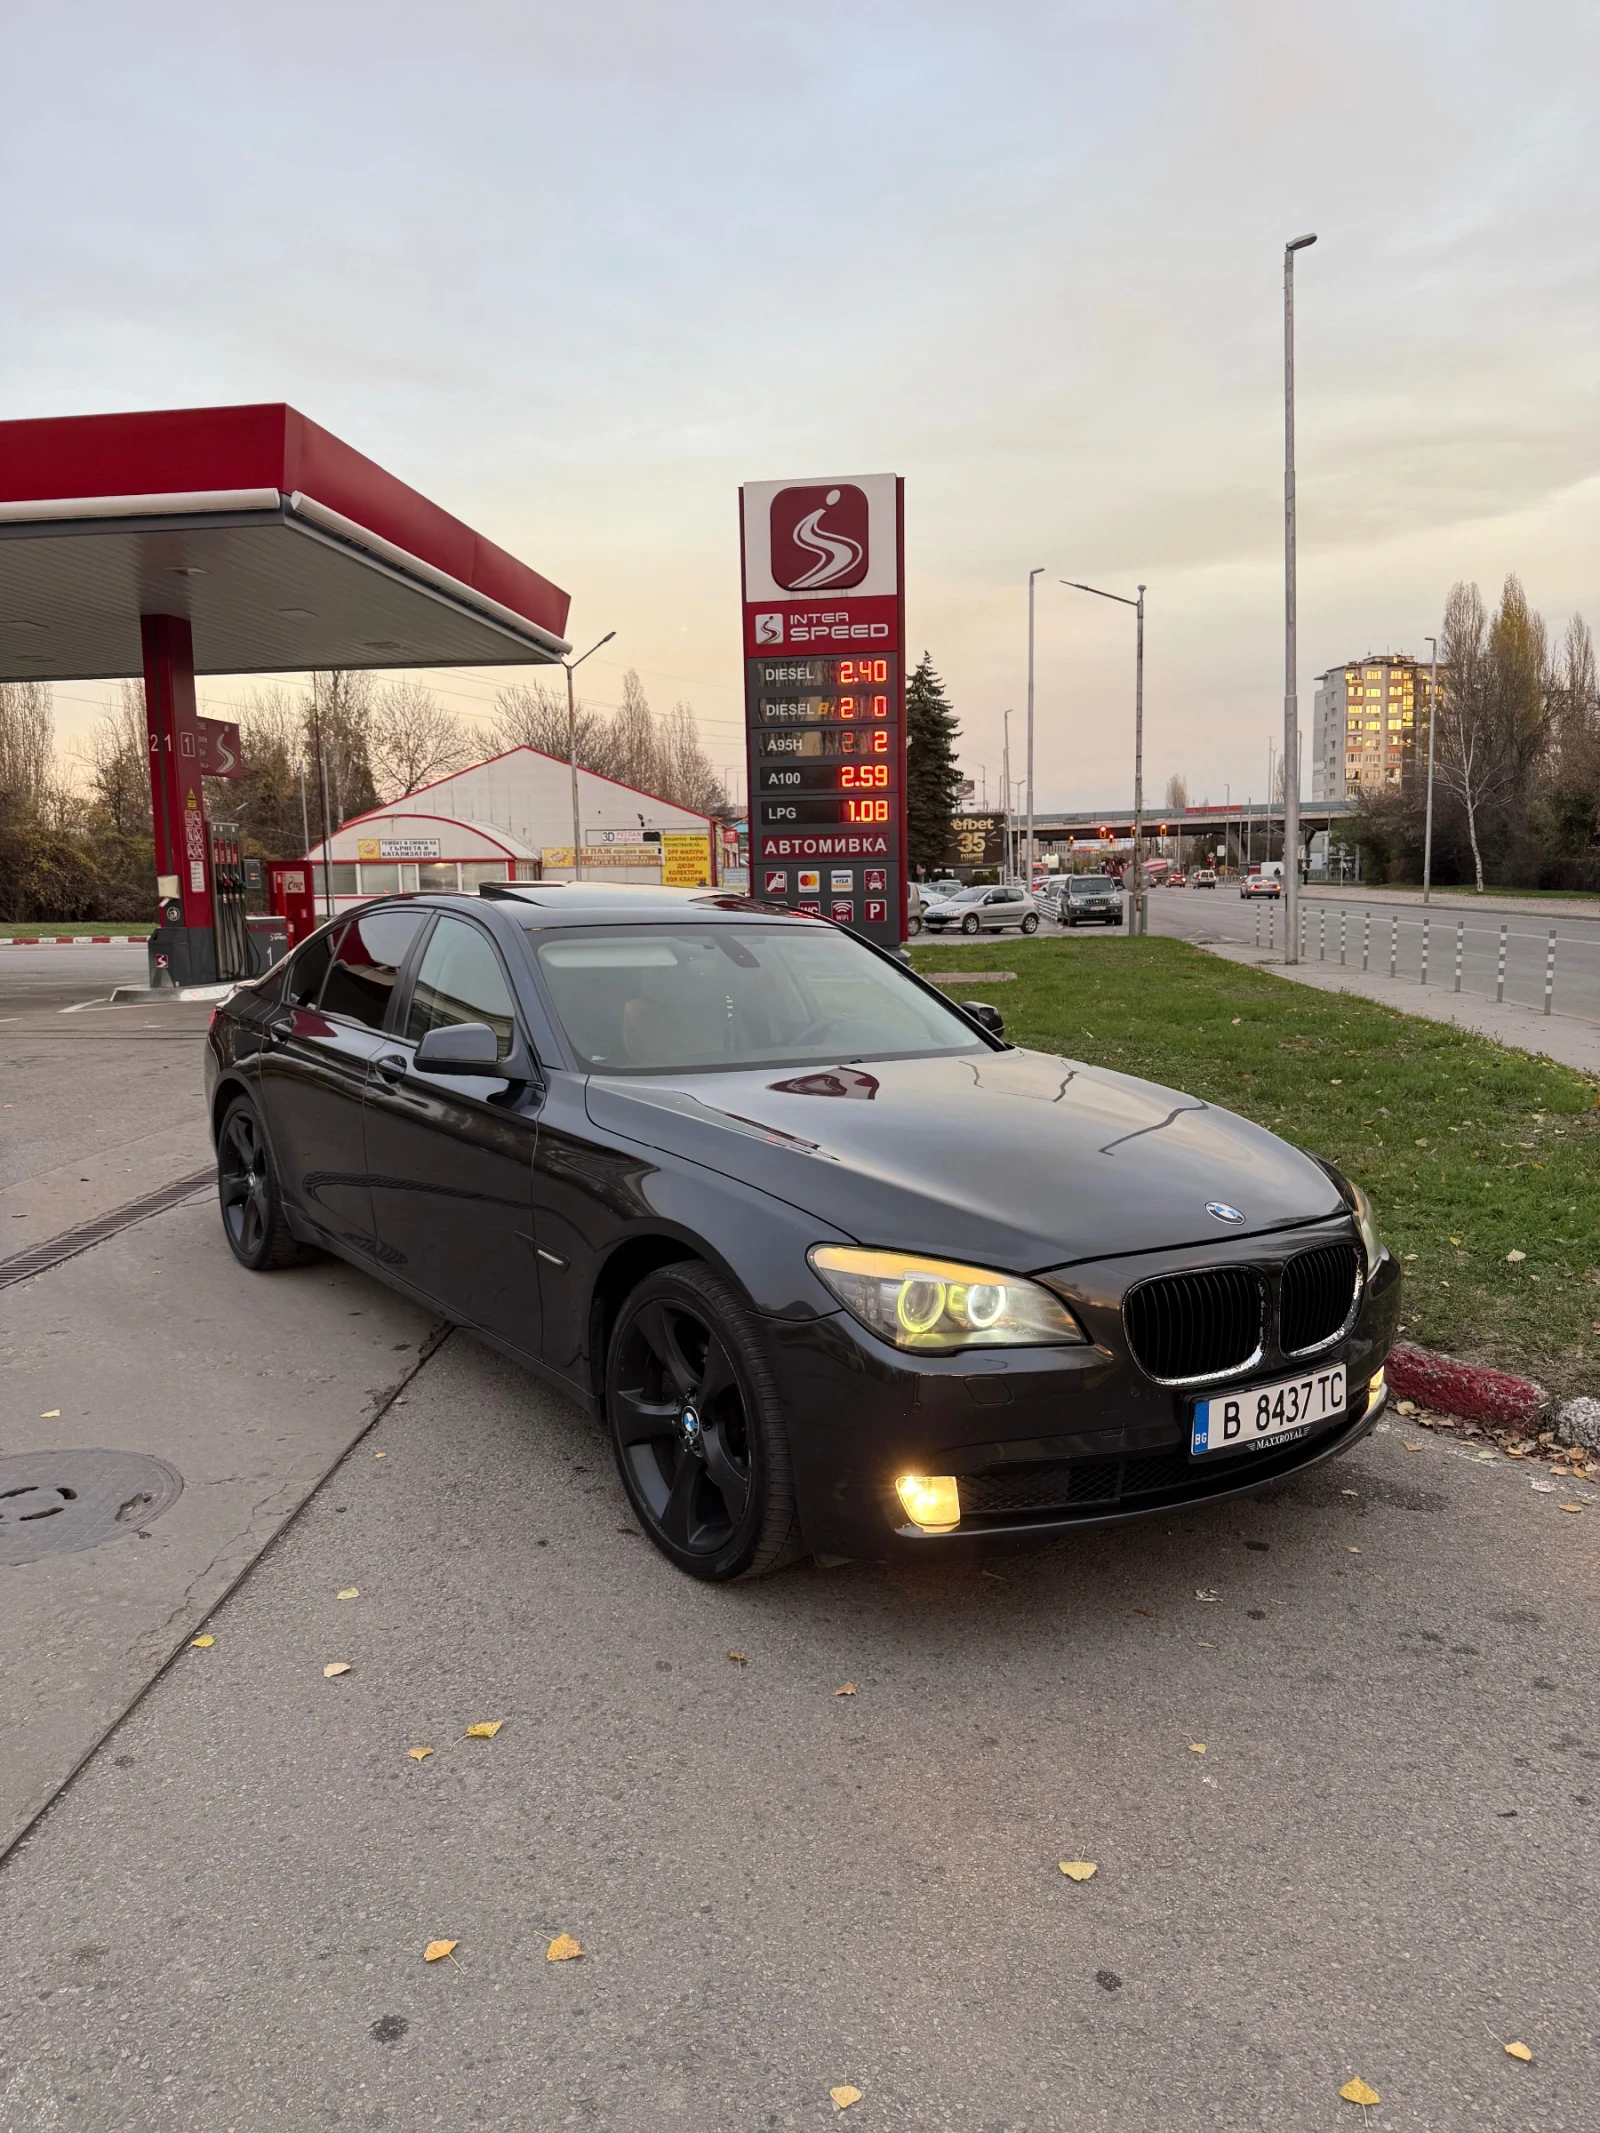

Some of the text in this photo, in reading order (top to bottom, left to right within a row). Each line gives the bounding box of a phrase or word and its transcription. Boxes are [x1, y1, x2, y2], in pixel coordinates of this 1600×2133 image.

[790, 612, 848, 624] INTER
[790, 624, 888, 642] SPEED
[766, 660, 886, 682] DIESEL 2.40
[766, 704, 814, 716] DIESEL
[150, 734, 171, 752] 2 1
[184, 736, 190, 753] 1
[767, 739, 802, 751] A95H
[768, 765, 888, 787] A100 2.59
[768, 801, 888, 822] LPG 1.08
[952, 818, 994, 830] efbet
[603, 832, 614, 841] 3D
[957, 832, 985, 852] 35
[764, 838, 887, 855] АВТОМИВКА
[870, 904, 880, 918] P
[266, 947, 272, 966] 1
[1223, 1372, 1342, 1440] B 8437 TC
[1195, 1432, 1207, 1445] BG
[1256, 1428, 1303, 1450] MAXXROYAL
